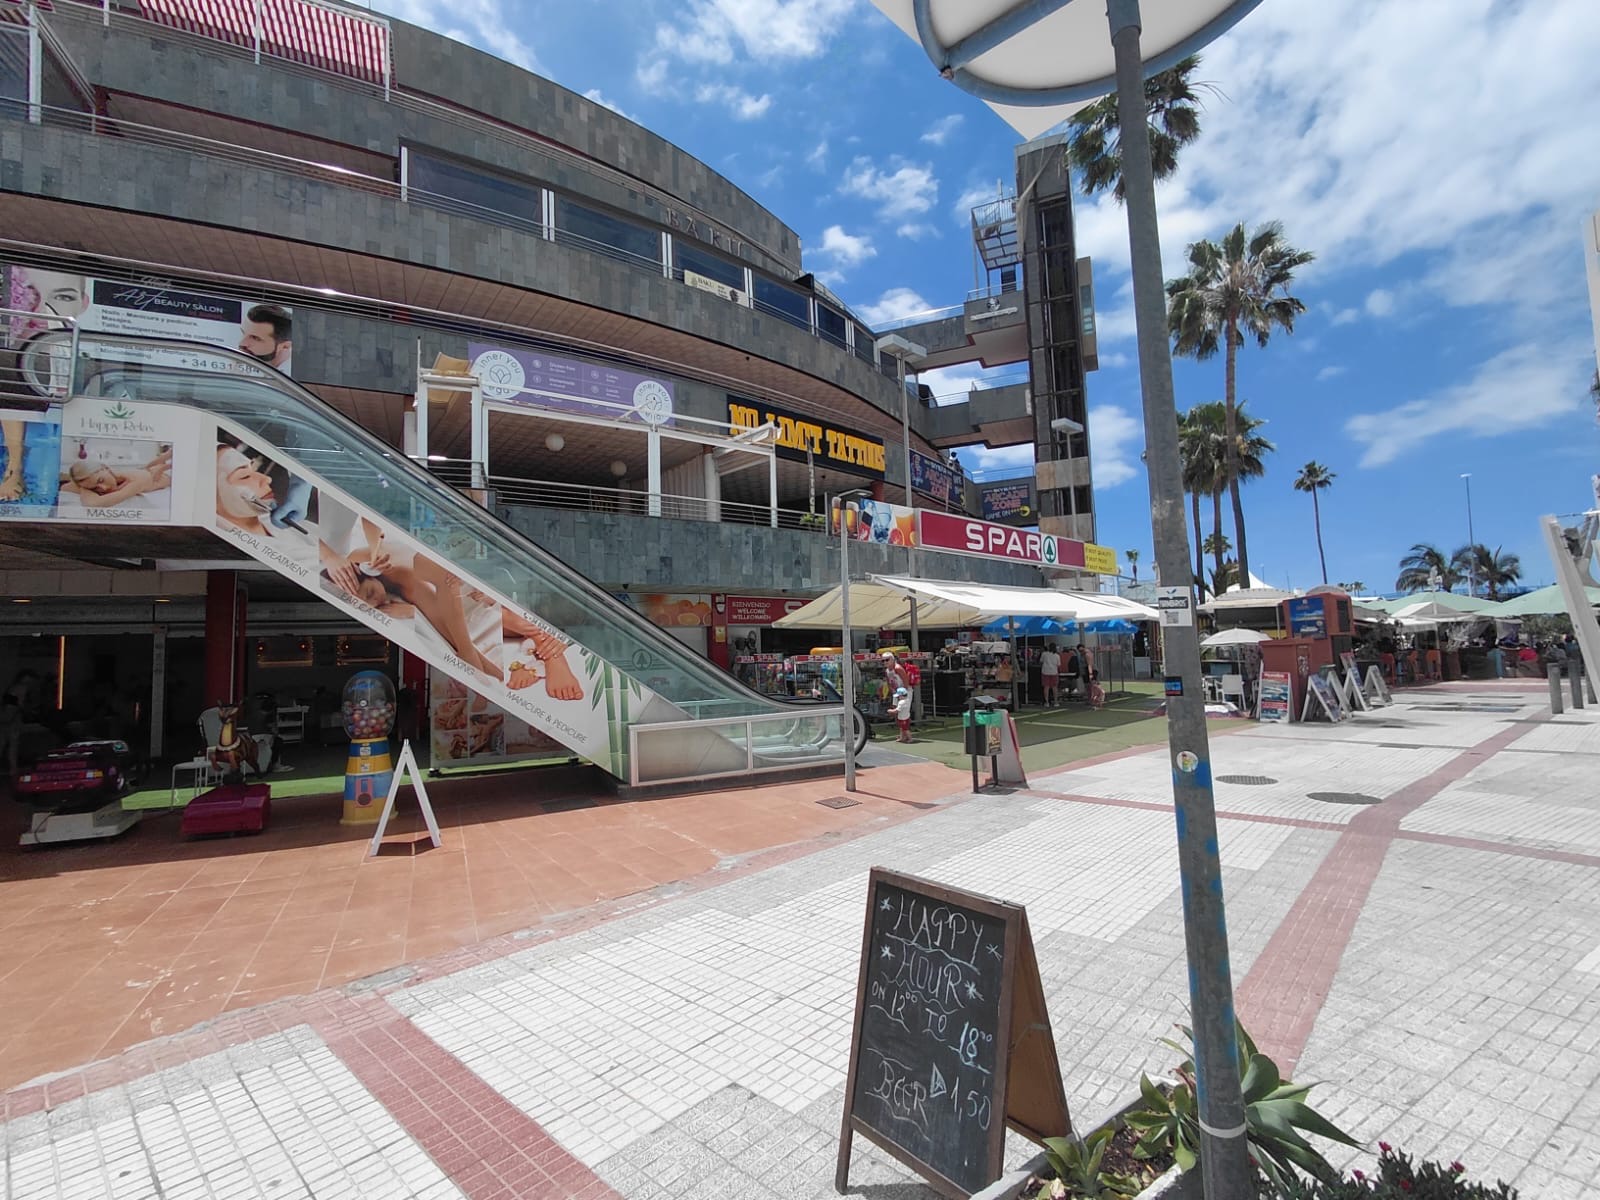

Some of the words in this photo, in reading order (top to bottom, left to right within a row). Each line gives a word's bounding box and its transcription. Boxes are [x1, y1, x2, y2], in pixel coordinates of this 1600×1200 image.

[154, 298, 191, 310] BEAUTY
[193, 303, 224, 314] SALON
[191, 358, 207, 368] 34
[211, 359, 234, 371] 631
[729, 403, 760, 437] NO
[826, 429, 886, 472] TATTOOS
[984, 489, 1028, 504] ARCADE
[992, 498, 1021, 511] ZONE
[1, 506, 23, 516] SPA
[87, 508, 144, 519] MASSAGE
[229, 526, 260, 551] FACIAL
[261, 544, 310, 579] TREATMENT
[965, 522, 1042, 560] SPAR
[358, 604, 393, 628] CANDLE
[732, 601, 771, 609] BIENVENIDO
[443, 653, 476, 677] WAXING
[808, 654, 835, 662] SPAR
[864, 653, 881, 661] SPA
[506, 691, 546, 720] MANICURE
[552, 718, 589, 745] PEDICURE
[893, 893, 984, 966] HAPPY
[896, 945, 966, 1008] HOUR
[872, 980, 886, 1000] ON
[925, 1007, 948, 1033] TO
[873, 1058, 929, 1127] BEER
